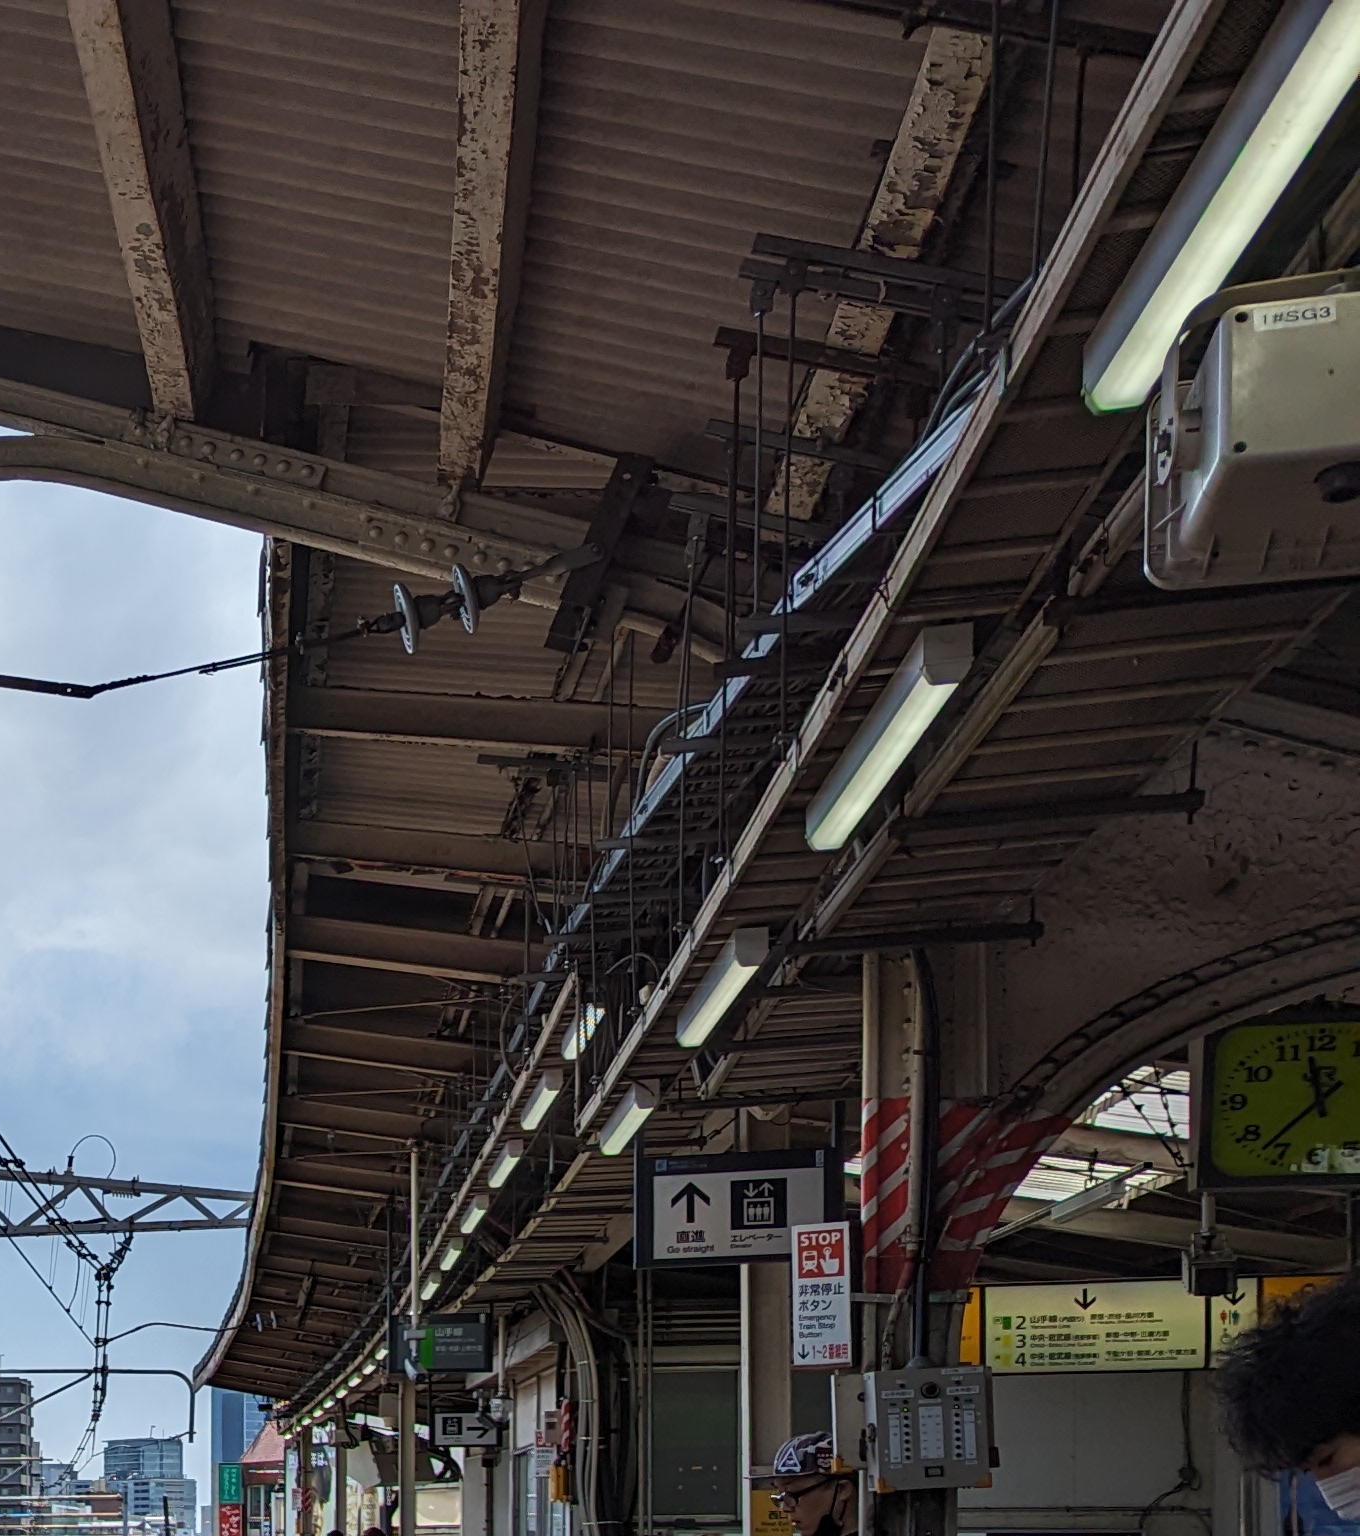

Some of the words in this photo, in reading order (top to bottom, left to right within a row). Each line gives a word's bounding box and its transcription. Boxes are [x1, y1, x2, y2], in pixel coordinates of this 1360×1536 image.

[1306, 1034, 1337, 1052] 12
[1275, 1044, 1301, 1062] 11
[1243, 1065, 1273, 1083] 10
[1229, 1093, 1248, 1111] 9
[1242, 1124, 1261, 1142] 8
[1273, 1142, 1292, 1162] 7
[676, 1230, 706, 1244] 直進
[730, 1233, 782, 1244] エレベーター
[800, 1231, 841, 1248] STOP
[667, 1246, 679, 1255] Go
[683, 1244, 714, 1255] straight
[798, 1282, 845, 1298] 非常停止
[798, 1299, 832, 1312] ボタン
[798, 1313, 837, 1323] Emergency
[1015, 1315, 1027, 1330] 2
[799, 1322, 816, 1330] Train
[818, 1321, 836, 1331] Stop
[798, 1330, 823, 1339] Button
[1015, 1334, 1027, 1349] 3
[1015, 1353, 1027, 1367] 4
